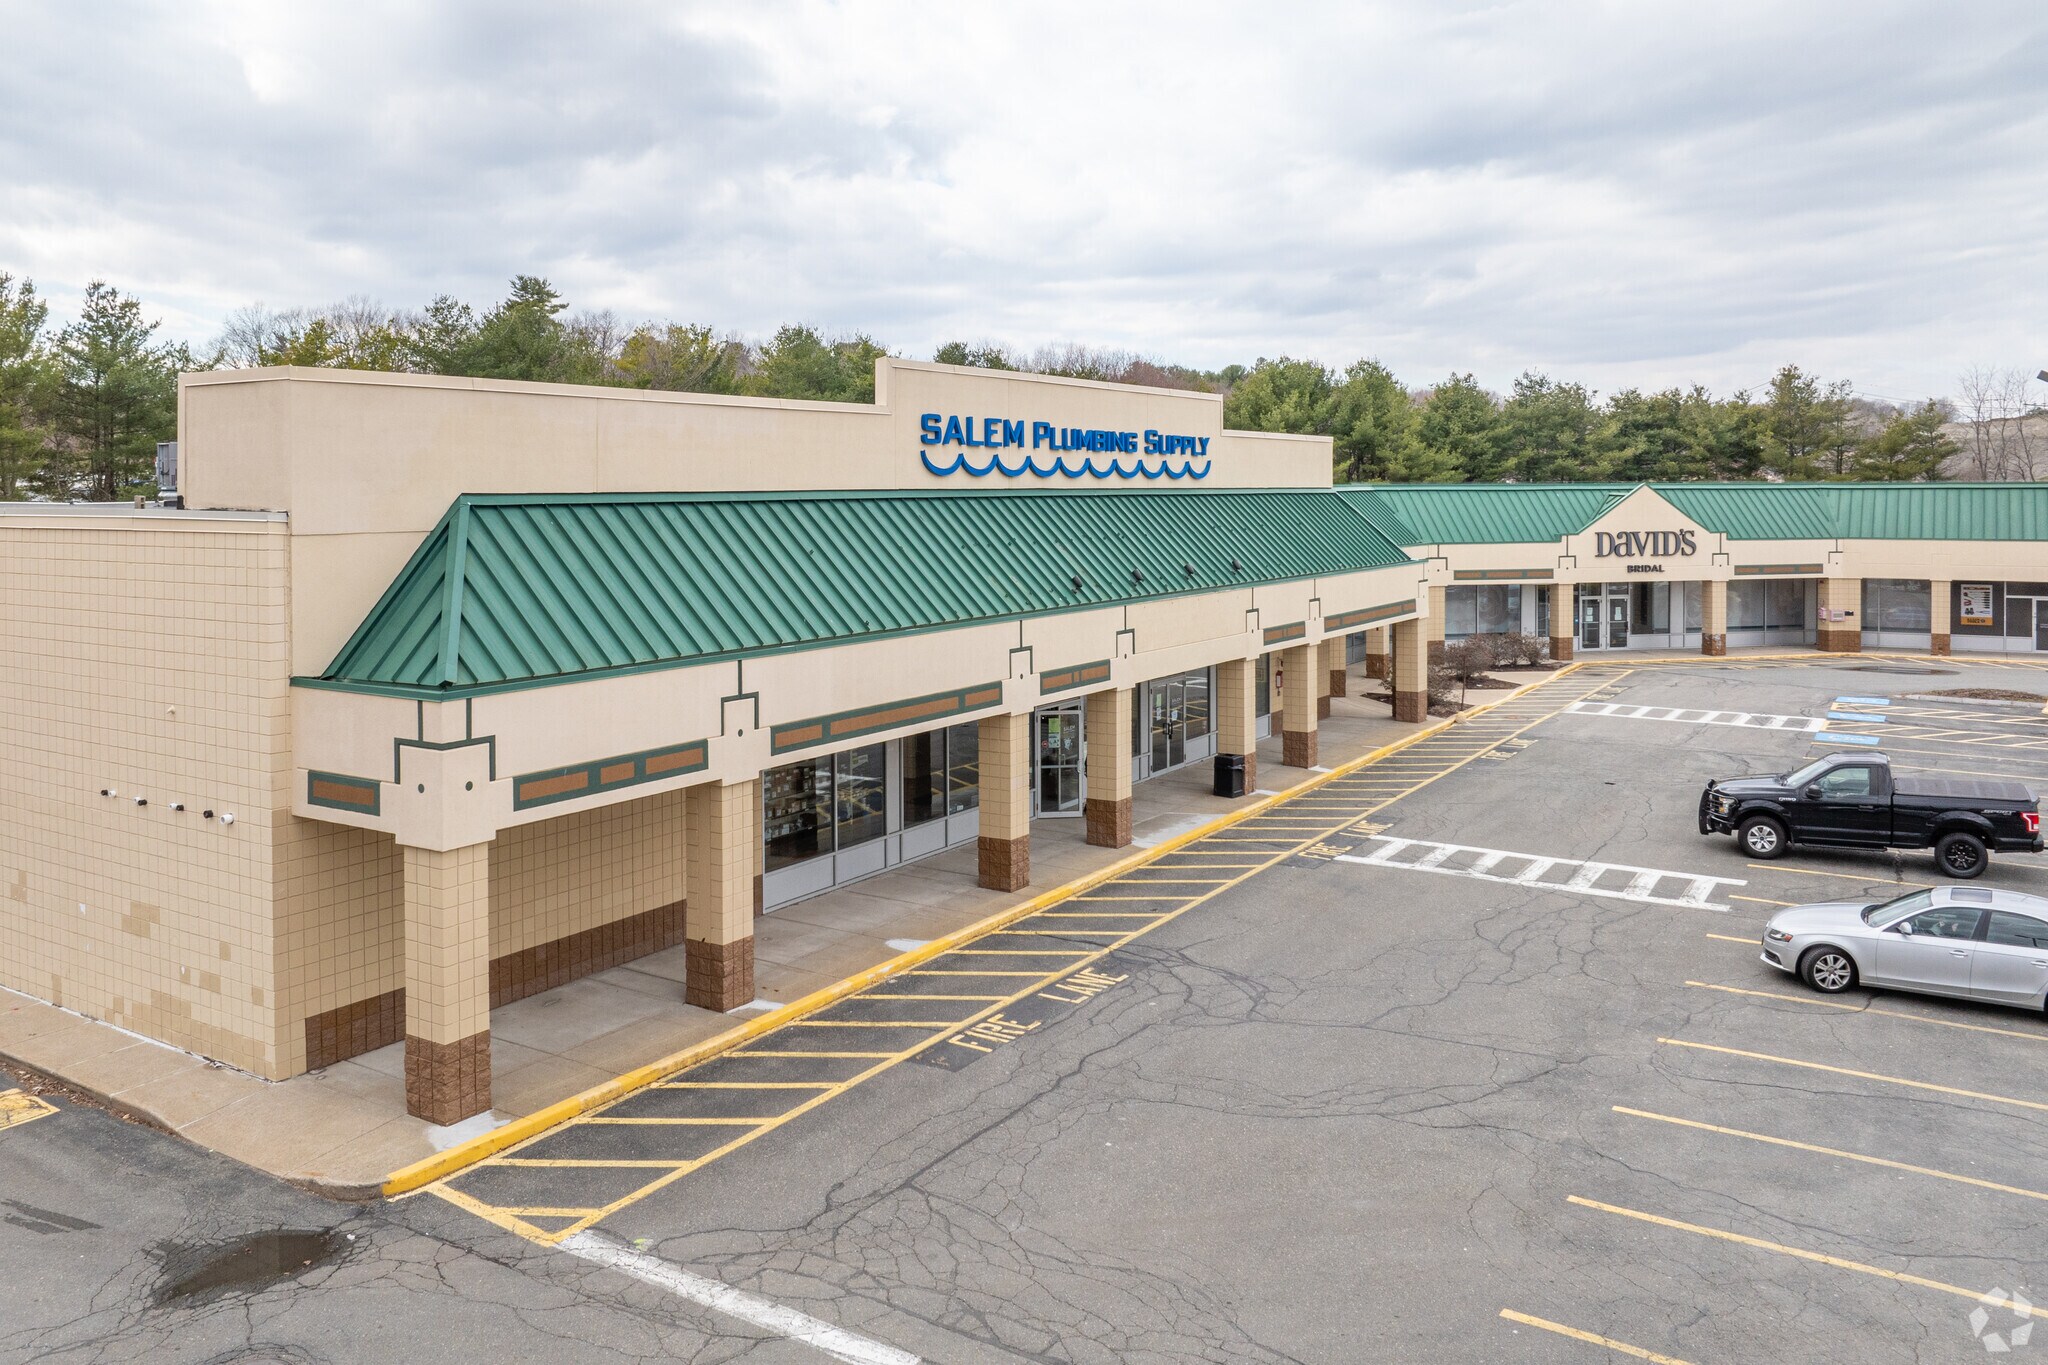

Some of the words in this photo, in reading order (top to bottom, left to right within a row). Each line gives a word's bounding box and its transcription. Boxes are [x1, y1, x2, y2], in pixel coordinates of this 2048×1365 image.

[920, 413, 1025, 448] SALEM
[1033, 421, 1138, 454] PLUMBING
[1144, 429, 1211, 457] SUPPLY
[1627, 564, 1665, 574] BRIDAL
[1297, 842, 1353, 861] FIRE
[1338, 820, 1394, 839] LANE
[948, 1013, 1042, 1053] FIRE
[1037, 967, 1129, 1004] LANE
